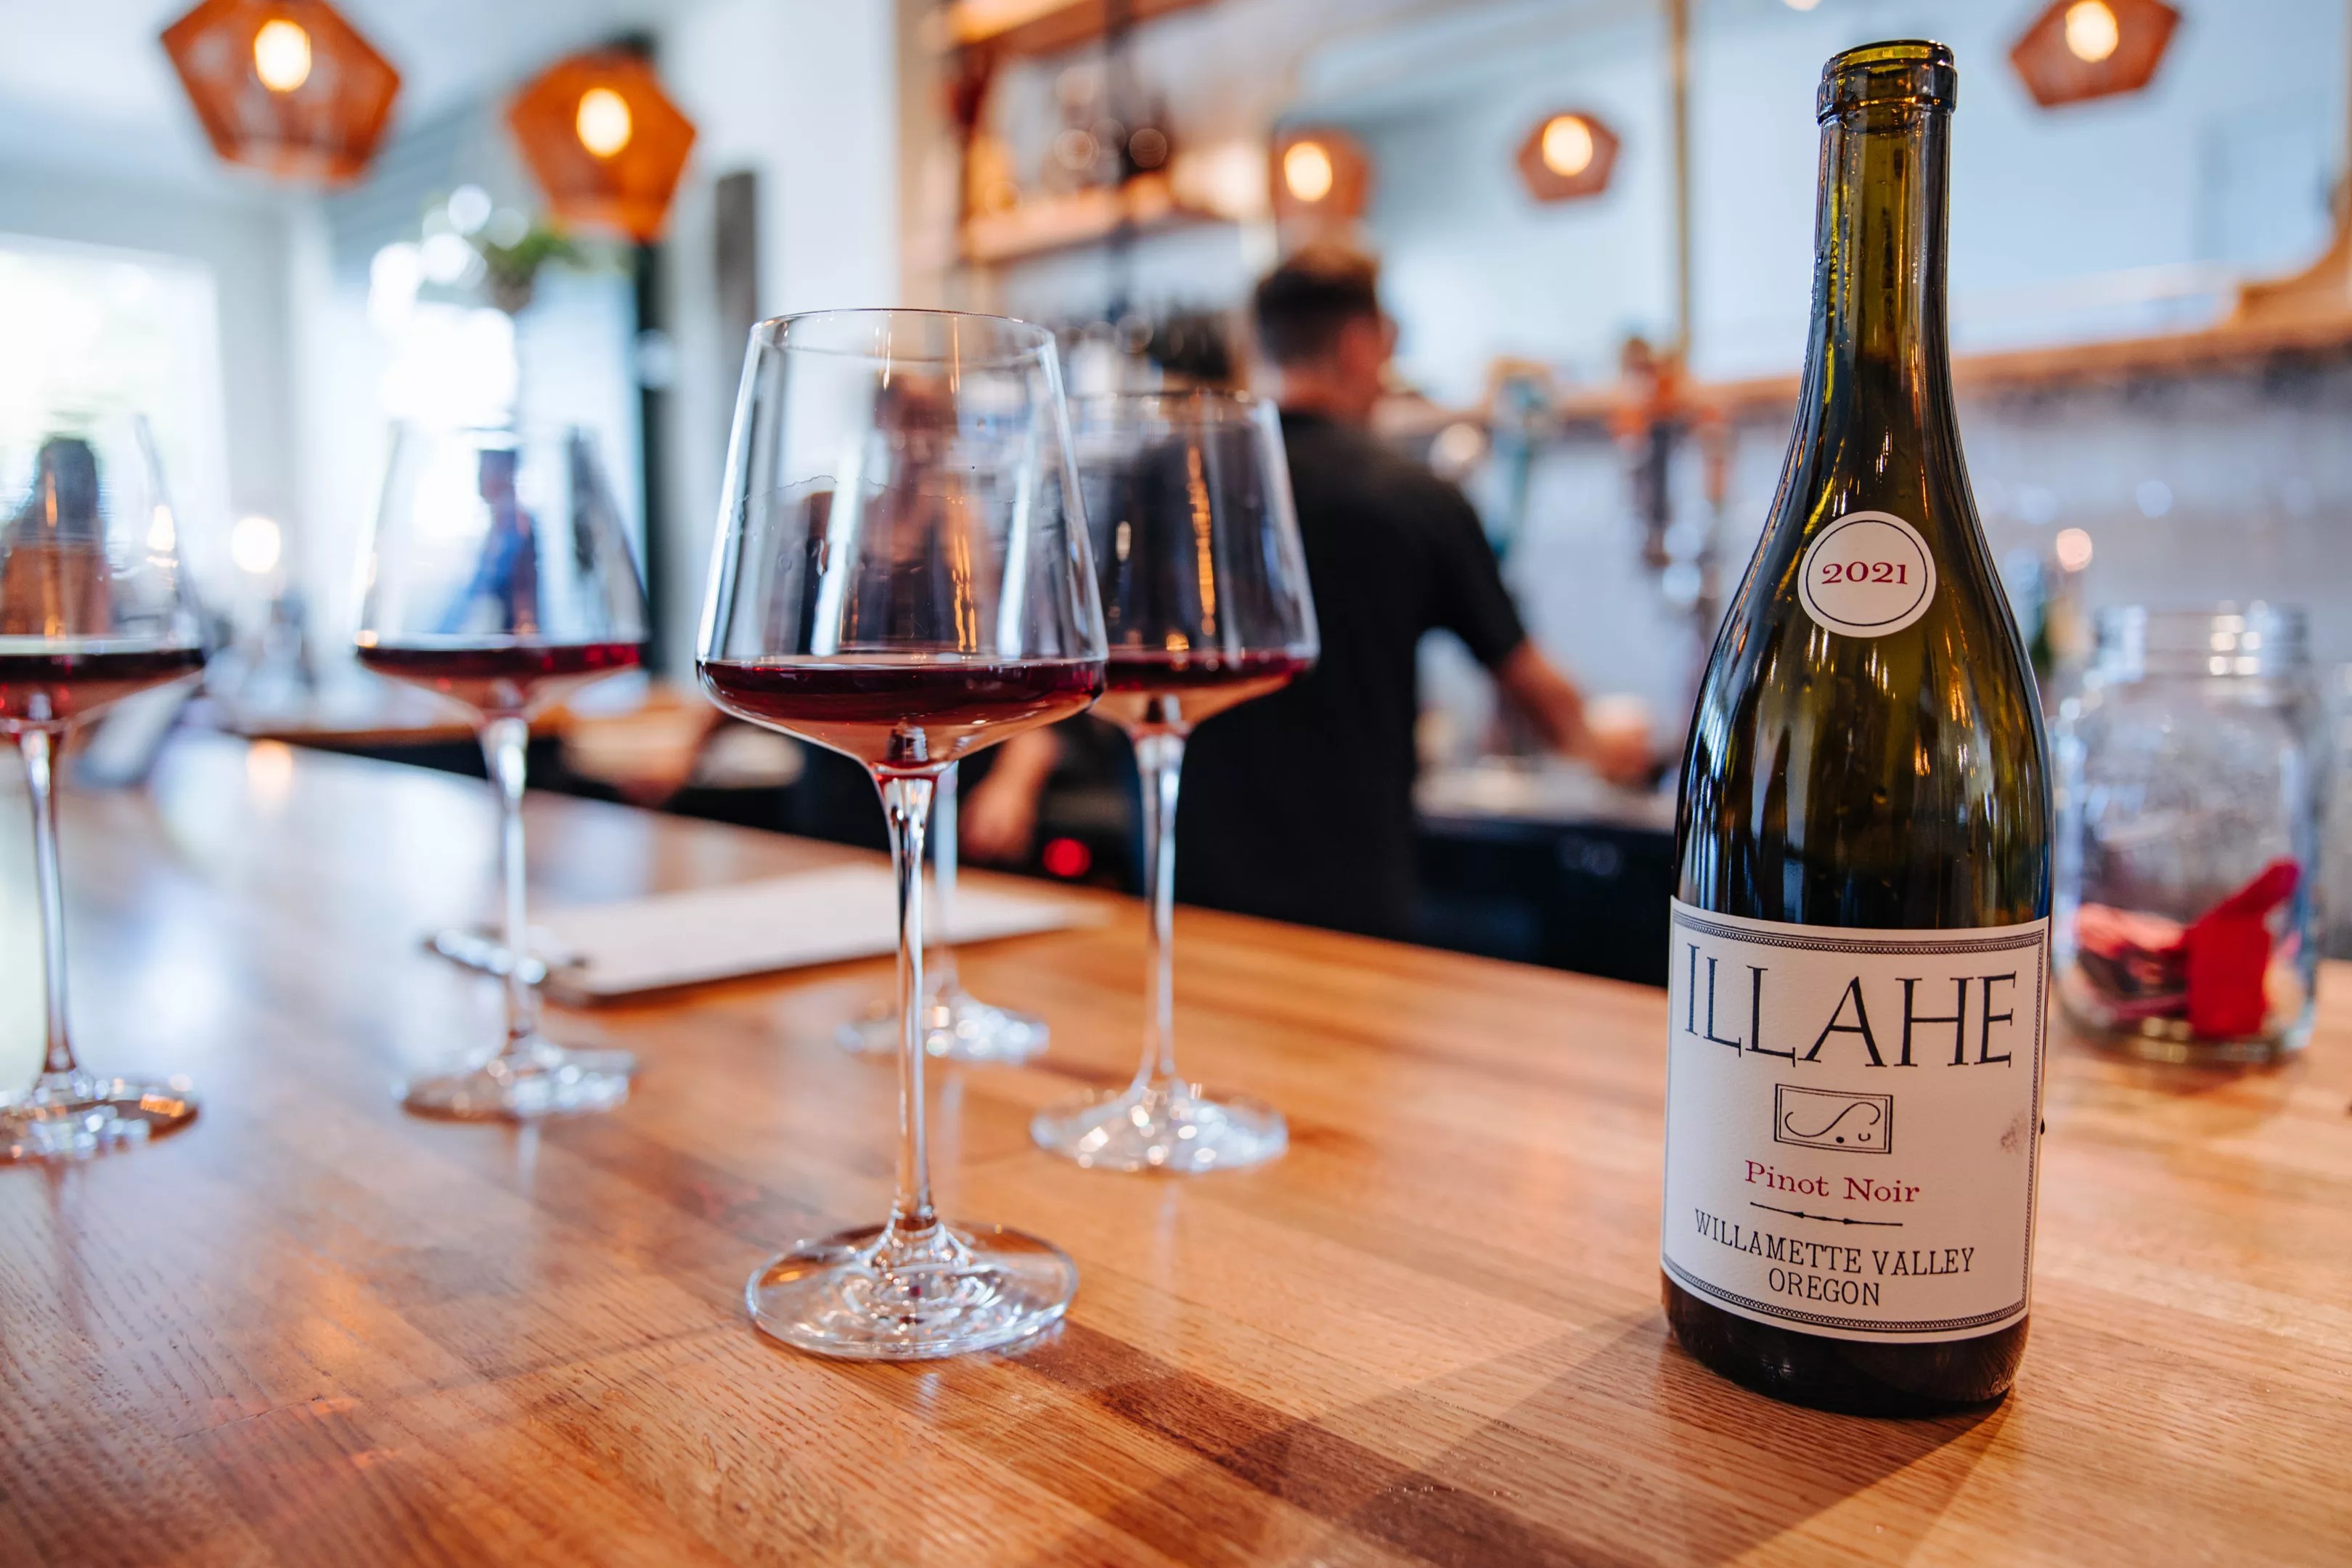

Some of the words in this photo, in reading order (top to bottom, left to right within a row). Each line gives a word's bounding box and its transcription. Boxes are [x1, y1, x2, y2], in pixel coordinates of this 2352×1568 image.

[1821, 561, 1908, 585] 2021
[1685, 943, 2017, 1068] ILLAHE
[1745, 1160, 1829, 1197] Pinot
[1842, 1177, 1920, 1203] Noir
[1695, 1208, 1862, 1274] WILLAMETTE
[1871, 1247, 1975, 1276] VALLEY
[1768, 1267, 1880, 1306] OREGON
